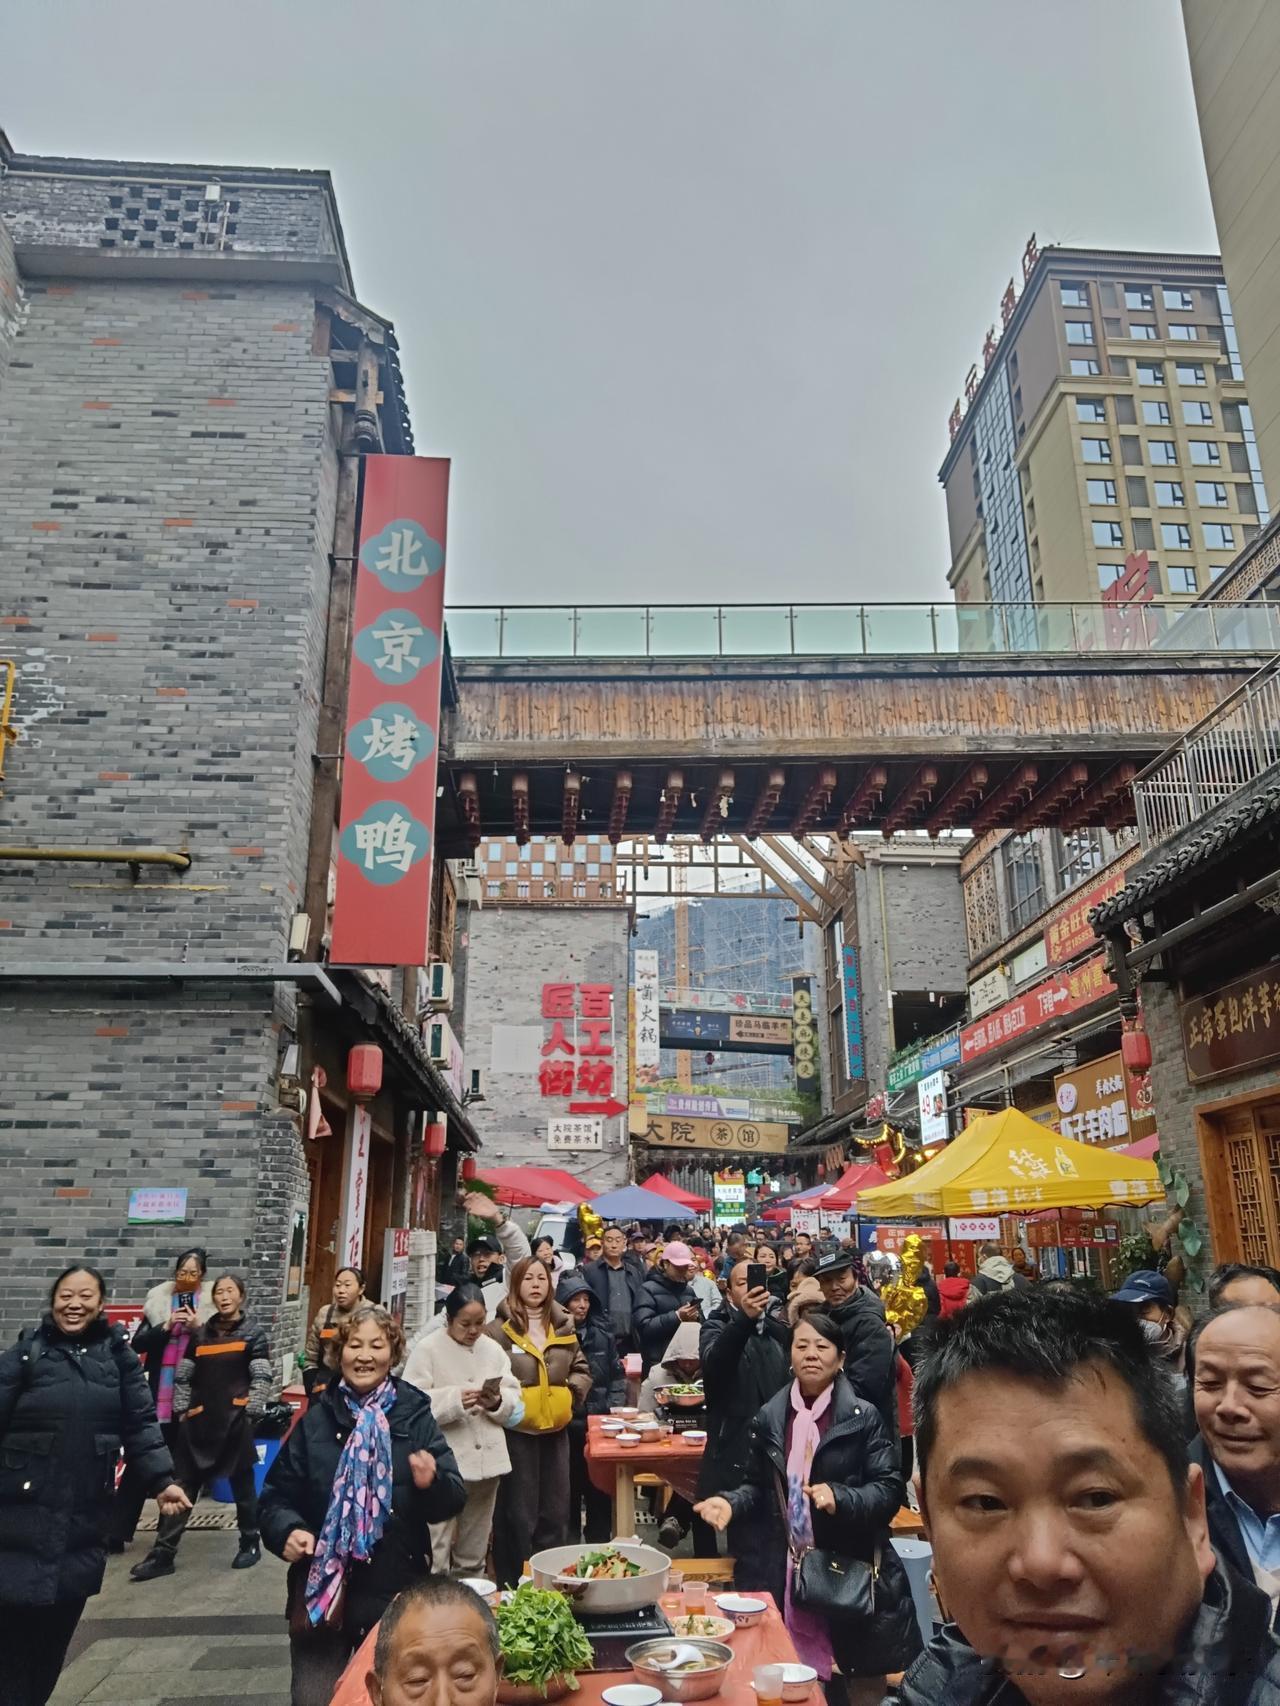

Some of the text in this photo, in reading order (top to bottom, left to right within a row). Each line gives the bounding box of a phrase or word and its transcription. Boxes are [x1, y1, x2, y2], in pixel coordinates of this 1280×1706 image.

[355, 529, 430, 871] 北京烤鸭
[578, 984, 614, 1097] 百工坊
[553, 1123, 592, 1133] 大院茶馆
[643, 1120, 755, 1144] 大院茶馆
